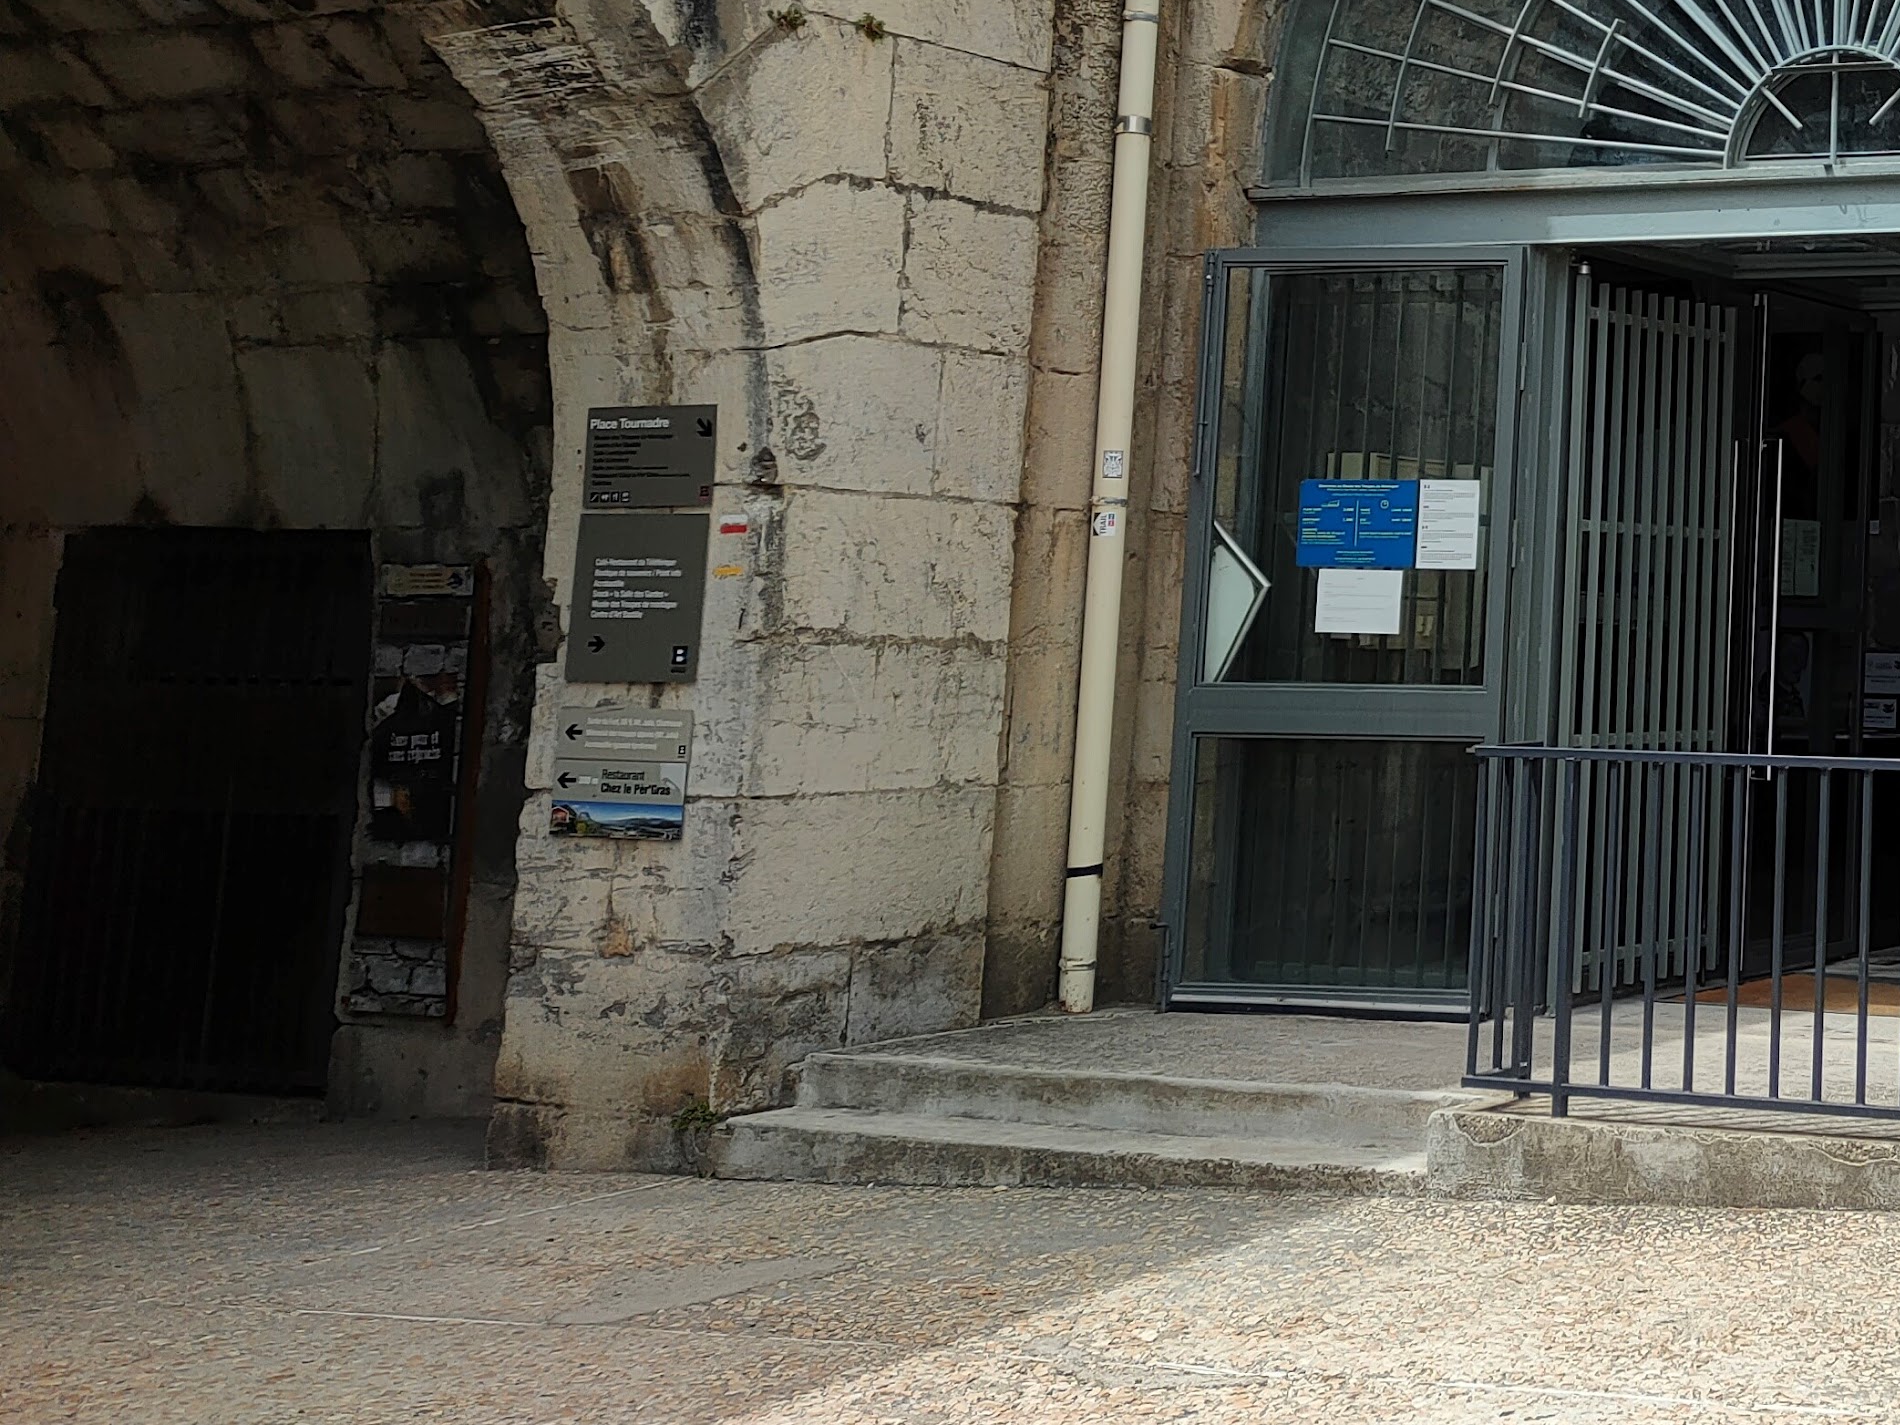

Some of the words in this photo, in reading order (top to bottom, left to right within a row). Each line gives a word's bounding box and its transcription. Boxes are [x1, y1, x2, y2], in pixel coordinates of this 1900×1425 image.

[590, 418, 618, 430] Place
[602, 769, 645, 781] Restaurant
[600, 782, 621, 793] Chez
[623, 783, 632, 794] le
